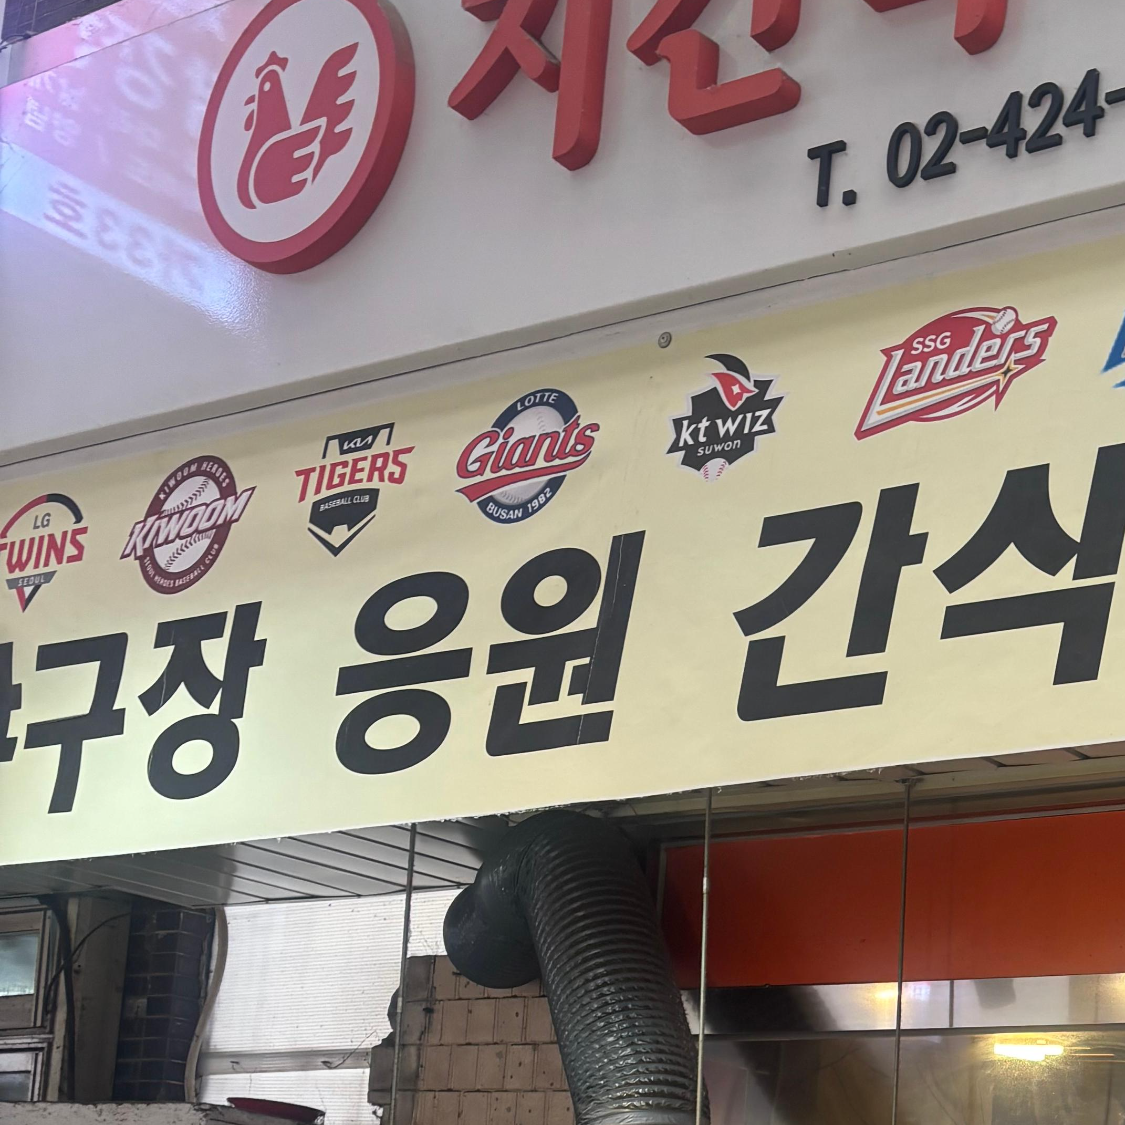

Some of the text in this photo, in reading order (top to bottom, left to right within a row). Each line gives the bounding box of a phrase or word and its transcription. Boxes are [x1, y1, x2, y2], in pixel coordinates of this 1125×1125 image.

[807, 139, 858, 208] T.
[911, 331, 952, 355] SSG
[860, 319, 1051, 432] Landers
[515, 391, 559, 412] LOTTE
[456, 414, 601, 480] Giants
[677, 415, 711, 448] kt
[158, 460, 230, 501] KIWOOM HEROES
[294, 445, 415, 503] TIGERS
[32, 511, 52, 530] LG
[319, 494, 370, 512] BASEBALL CLUB
[486, 486, 554, 521] BUSAN 1982
[121, 487, 256, 559] KIWOOM
[0, 525, 89, 575] TWINS
[17, 576, 46, 587] SEOUL
[175, 564, 206, 587] BASEBALL
[335, 530, 646, 775] 응원
